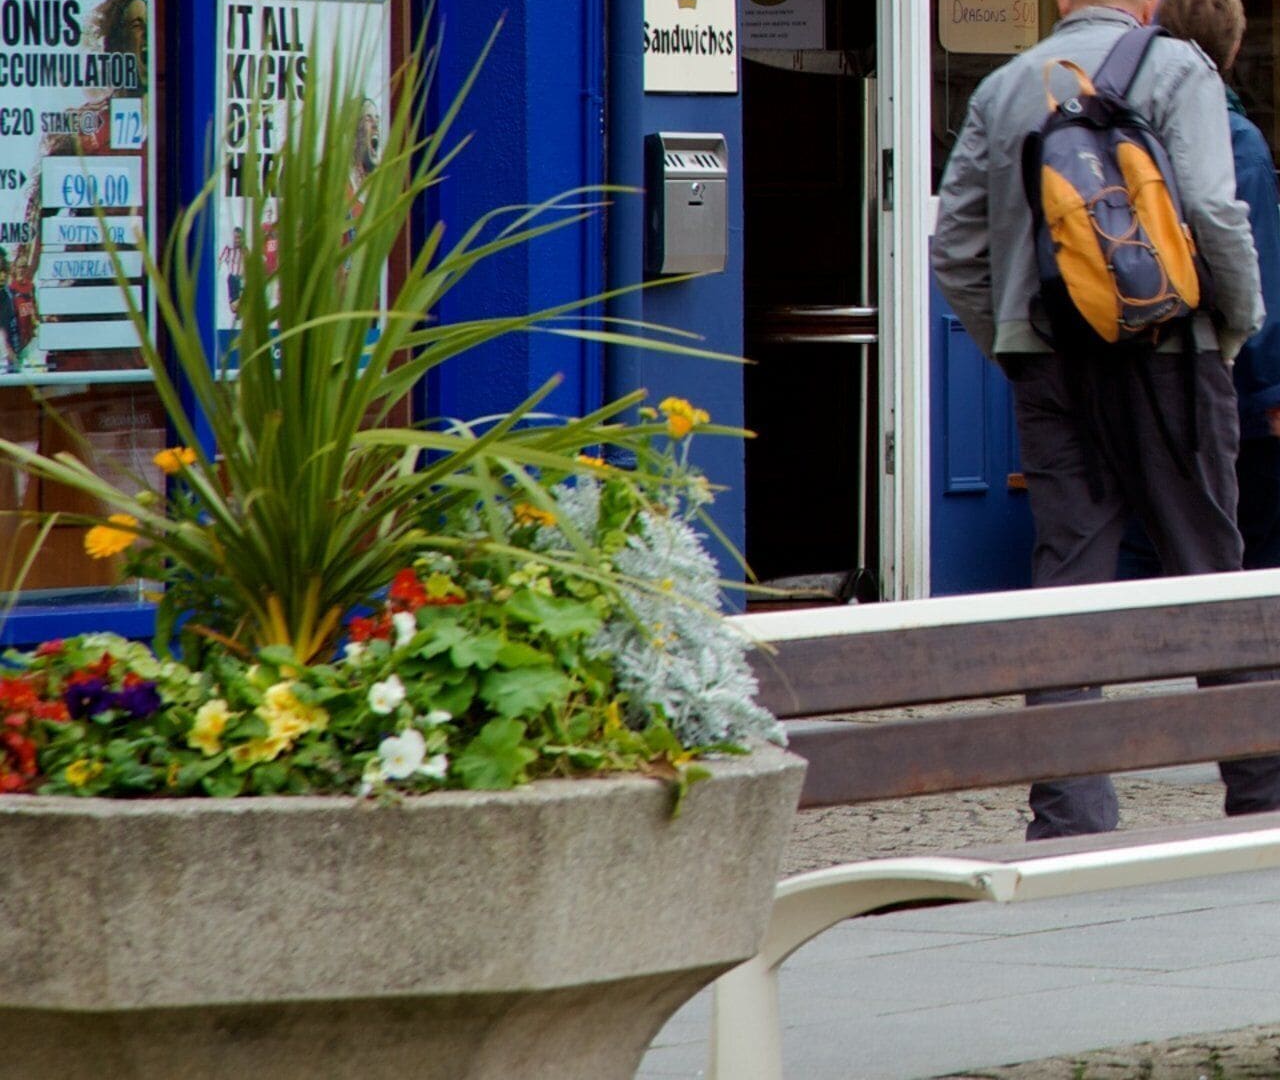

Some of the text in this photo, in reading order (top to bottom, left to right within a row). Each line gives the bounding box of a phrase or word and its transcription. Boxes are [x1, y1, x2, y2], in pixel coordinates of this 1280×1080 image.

[226, 4, 304, 52] IT ALL
[643, 22, 734, 56] Sandwiches
[226, 53, 308, 101] KICKS
[40, 111, 79, 134] STAKE
[114, 111, 142, 145] 7/2
[62, 174, 129, 207] €90.00
